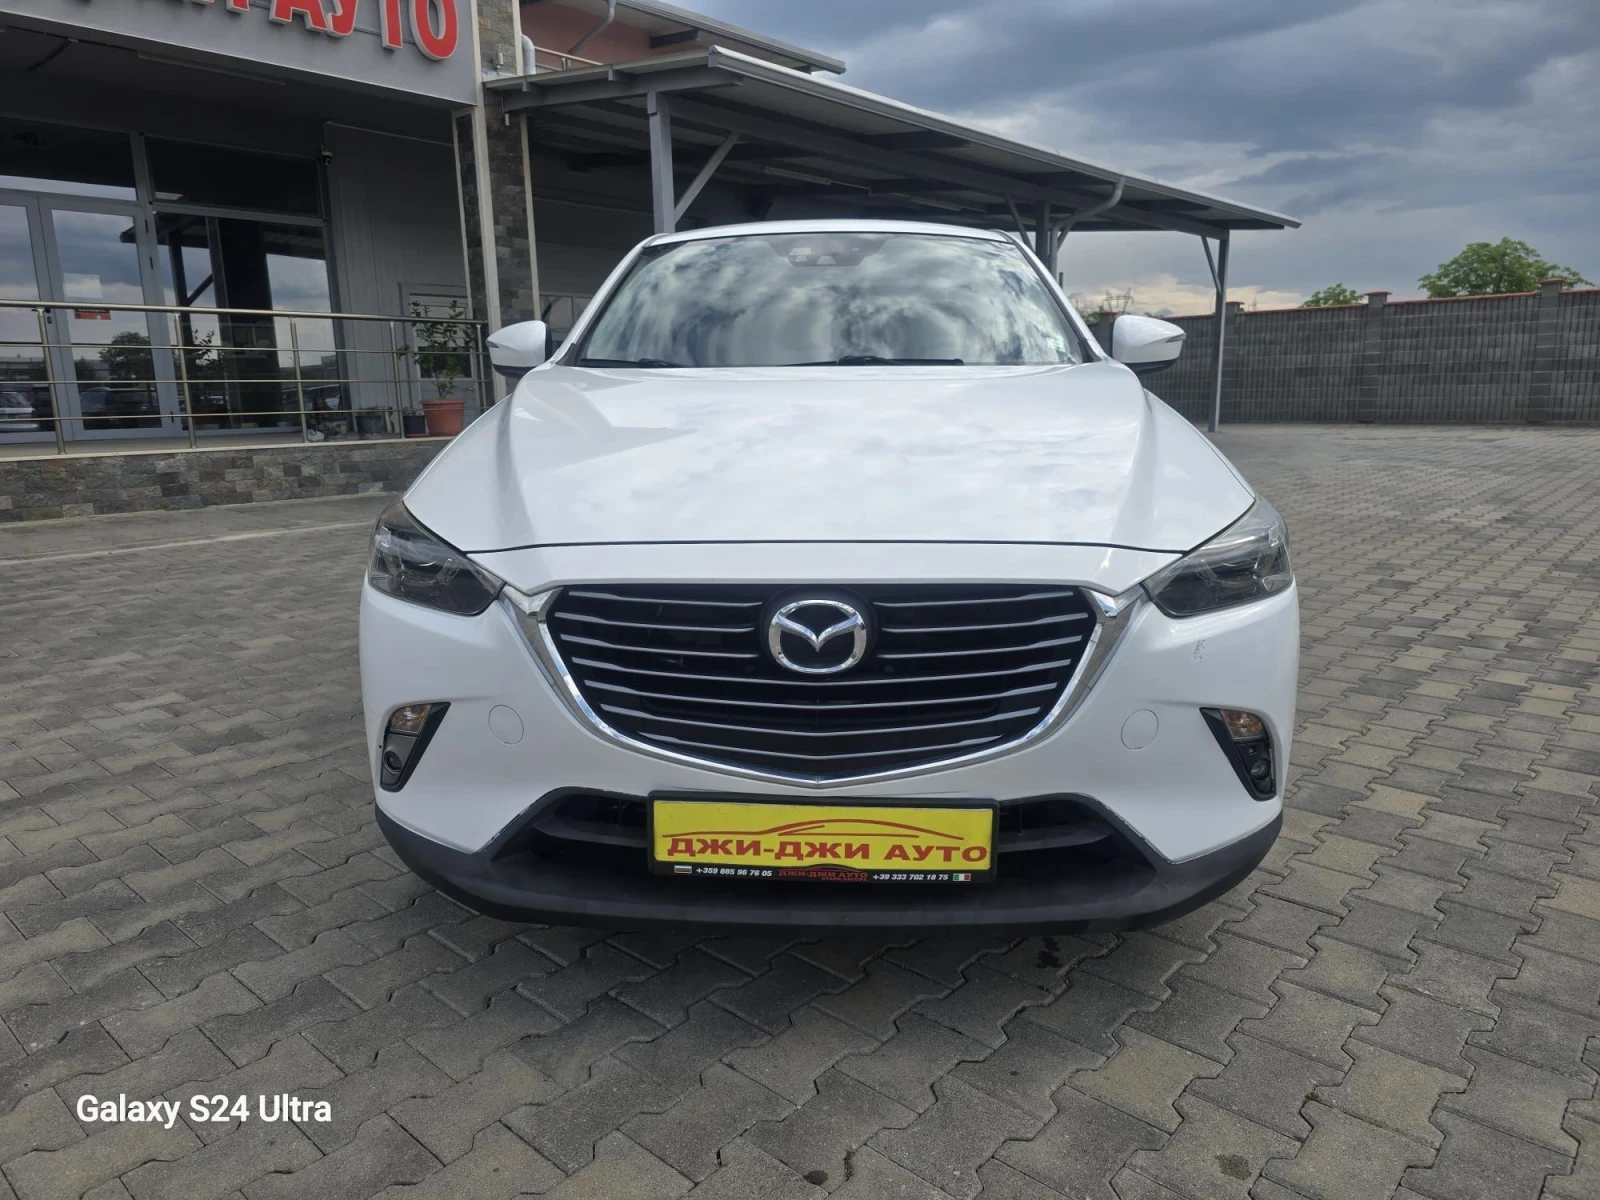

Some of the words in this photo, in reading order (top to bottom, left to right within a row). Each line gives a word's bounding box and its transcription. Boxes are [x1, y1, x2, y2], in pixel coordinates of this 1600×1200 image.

[667, 838, 870, 861] ДЖИ-ДЖИ
[884, 844, 988, 862] АУТО
[696, 867, 718, 875] +359
[720, 868, 735, 876] 885
[737, 868, 748, 876] 96
[750, 869, 760, 877] 76
[909, 873, 924, 881] 702
[926, 873, 936, 881] 18
[938, 873, 949, 881] 75
